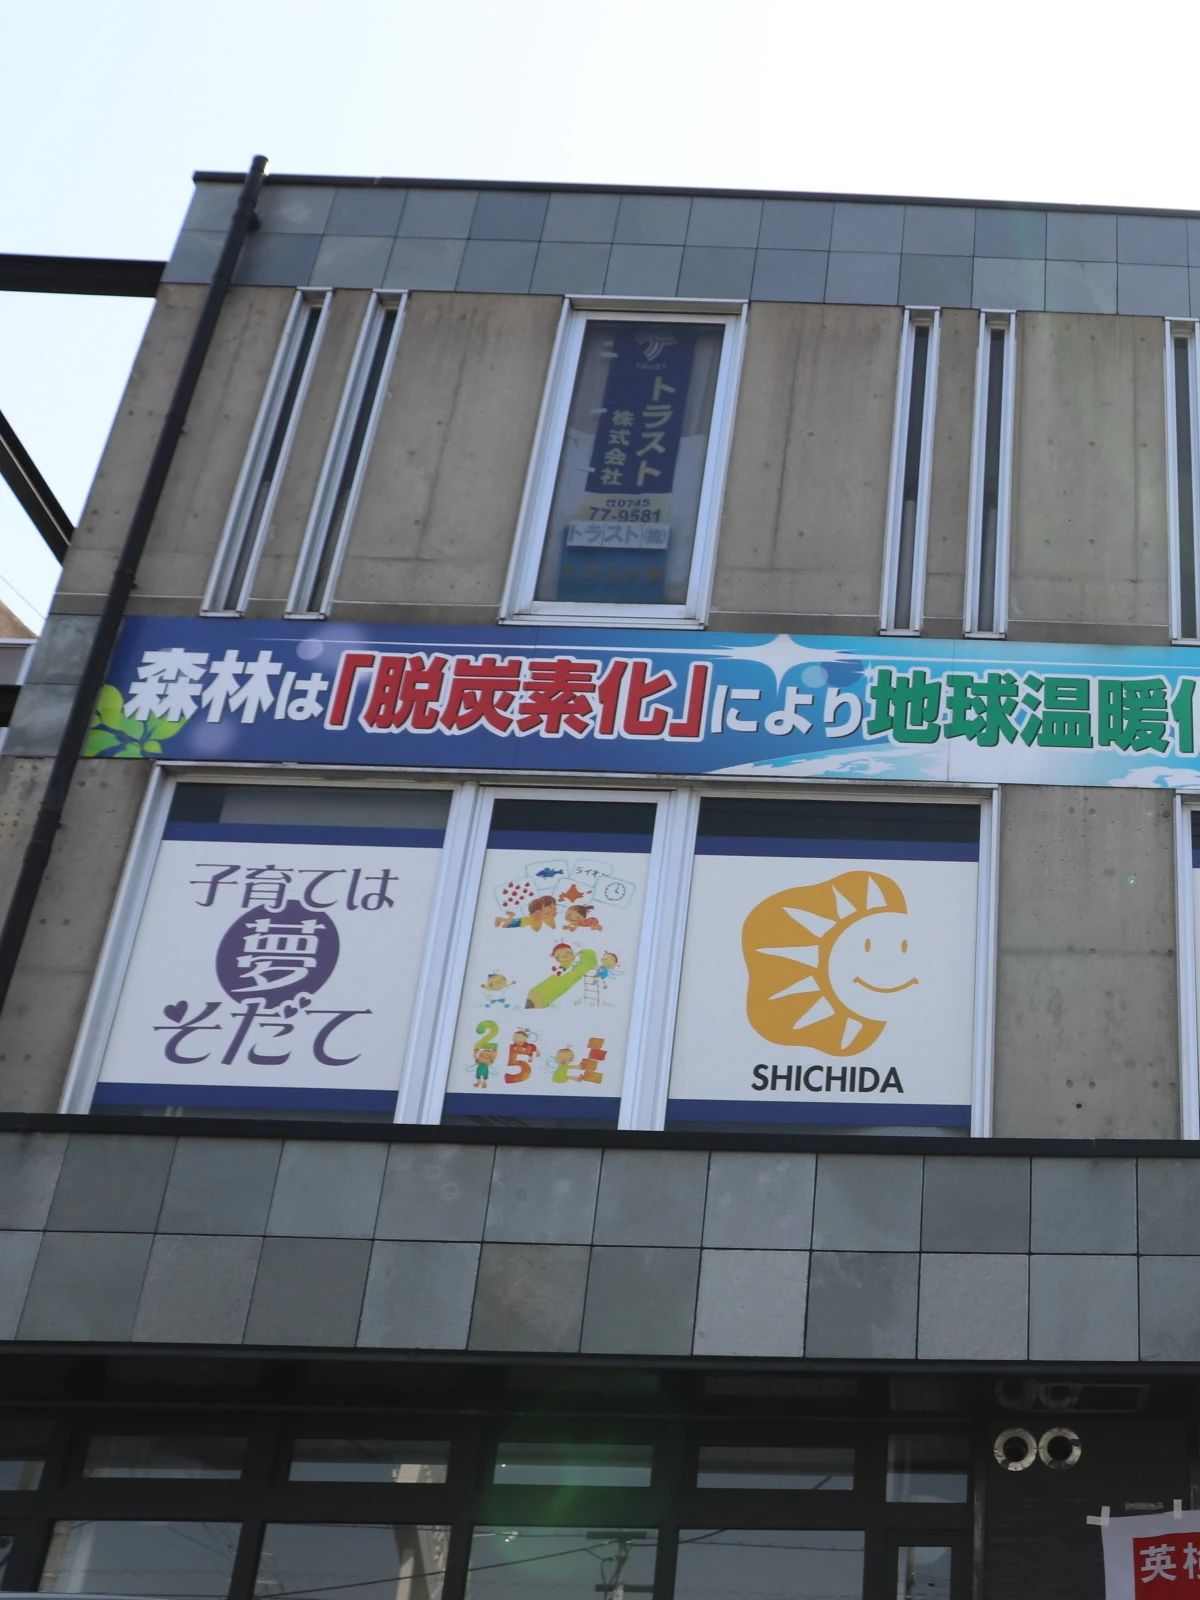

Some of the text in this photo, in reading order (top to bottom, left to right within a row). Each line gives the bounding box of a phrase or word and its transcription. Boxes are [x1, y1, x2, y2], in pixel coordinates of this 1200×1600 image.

[601, 409, 635, 486] 株式会社
[635, 376, 677, 487] トラスト
[589, 506, 662, 523] 77-9581
[189, 864, 399, 911] 子育ては
[230, 918, 327, 993] 夢
[153, 998, 373, 1067] そだて
[751, 1063, 905, 1094] SHICHIDA
